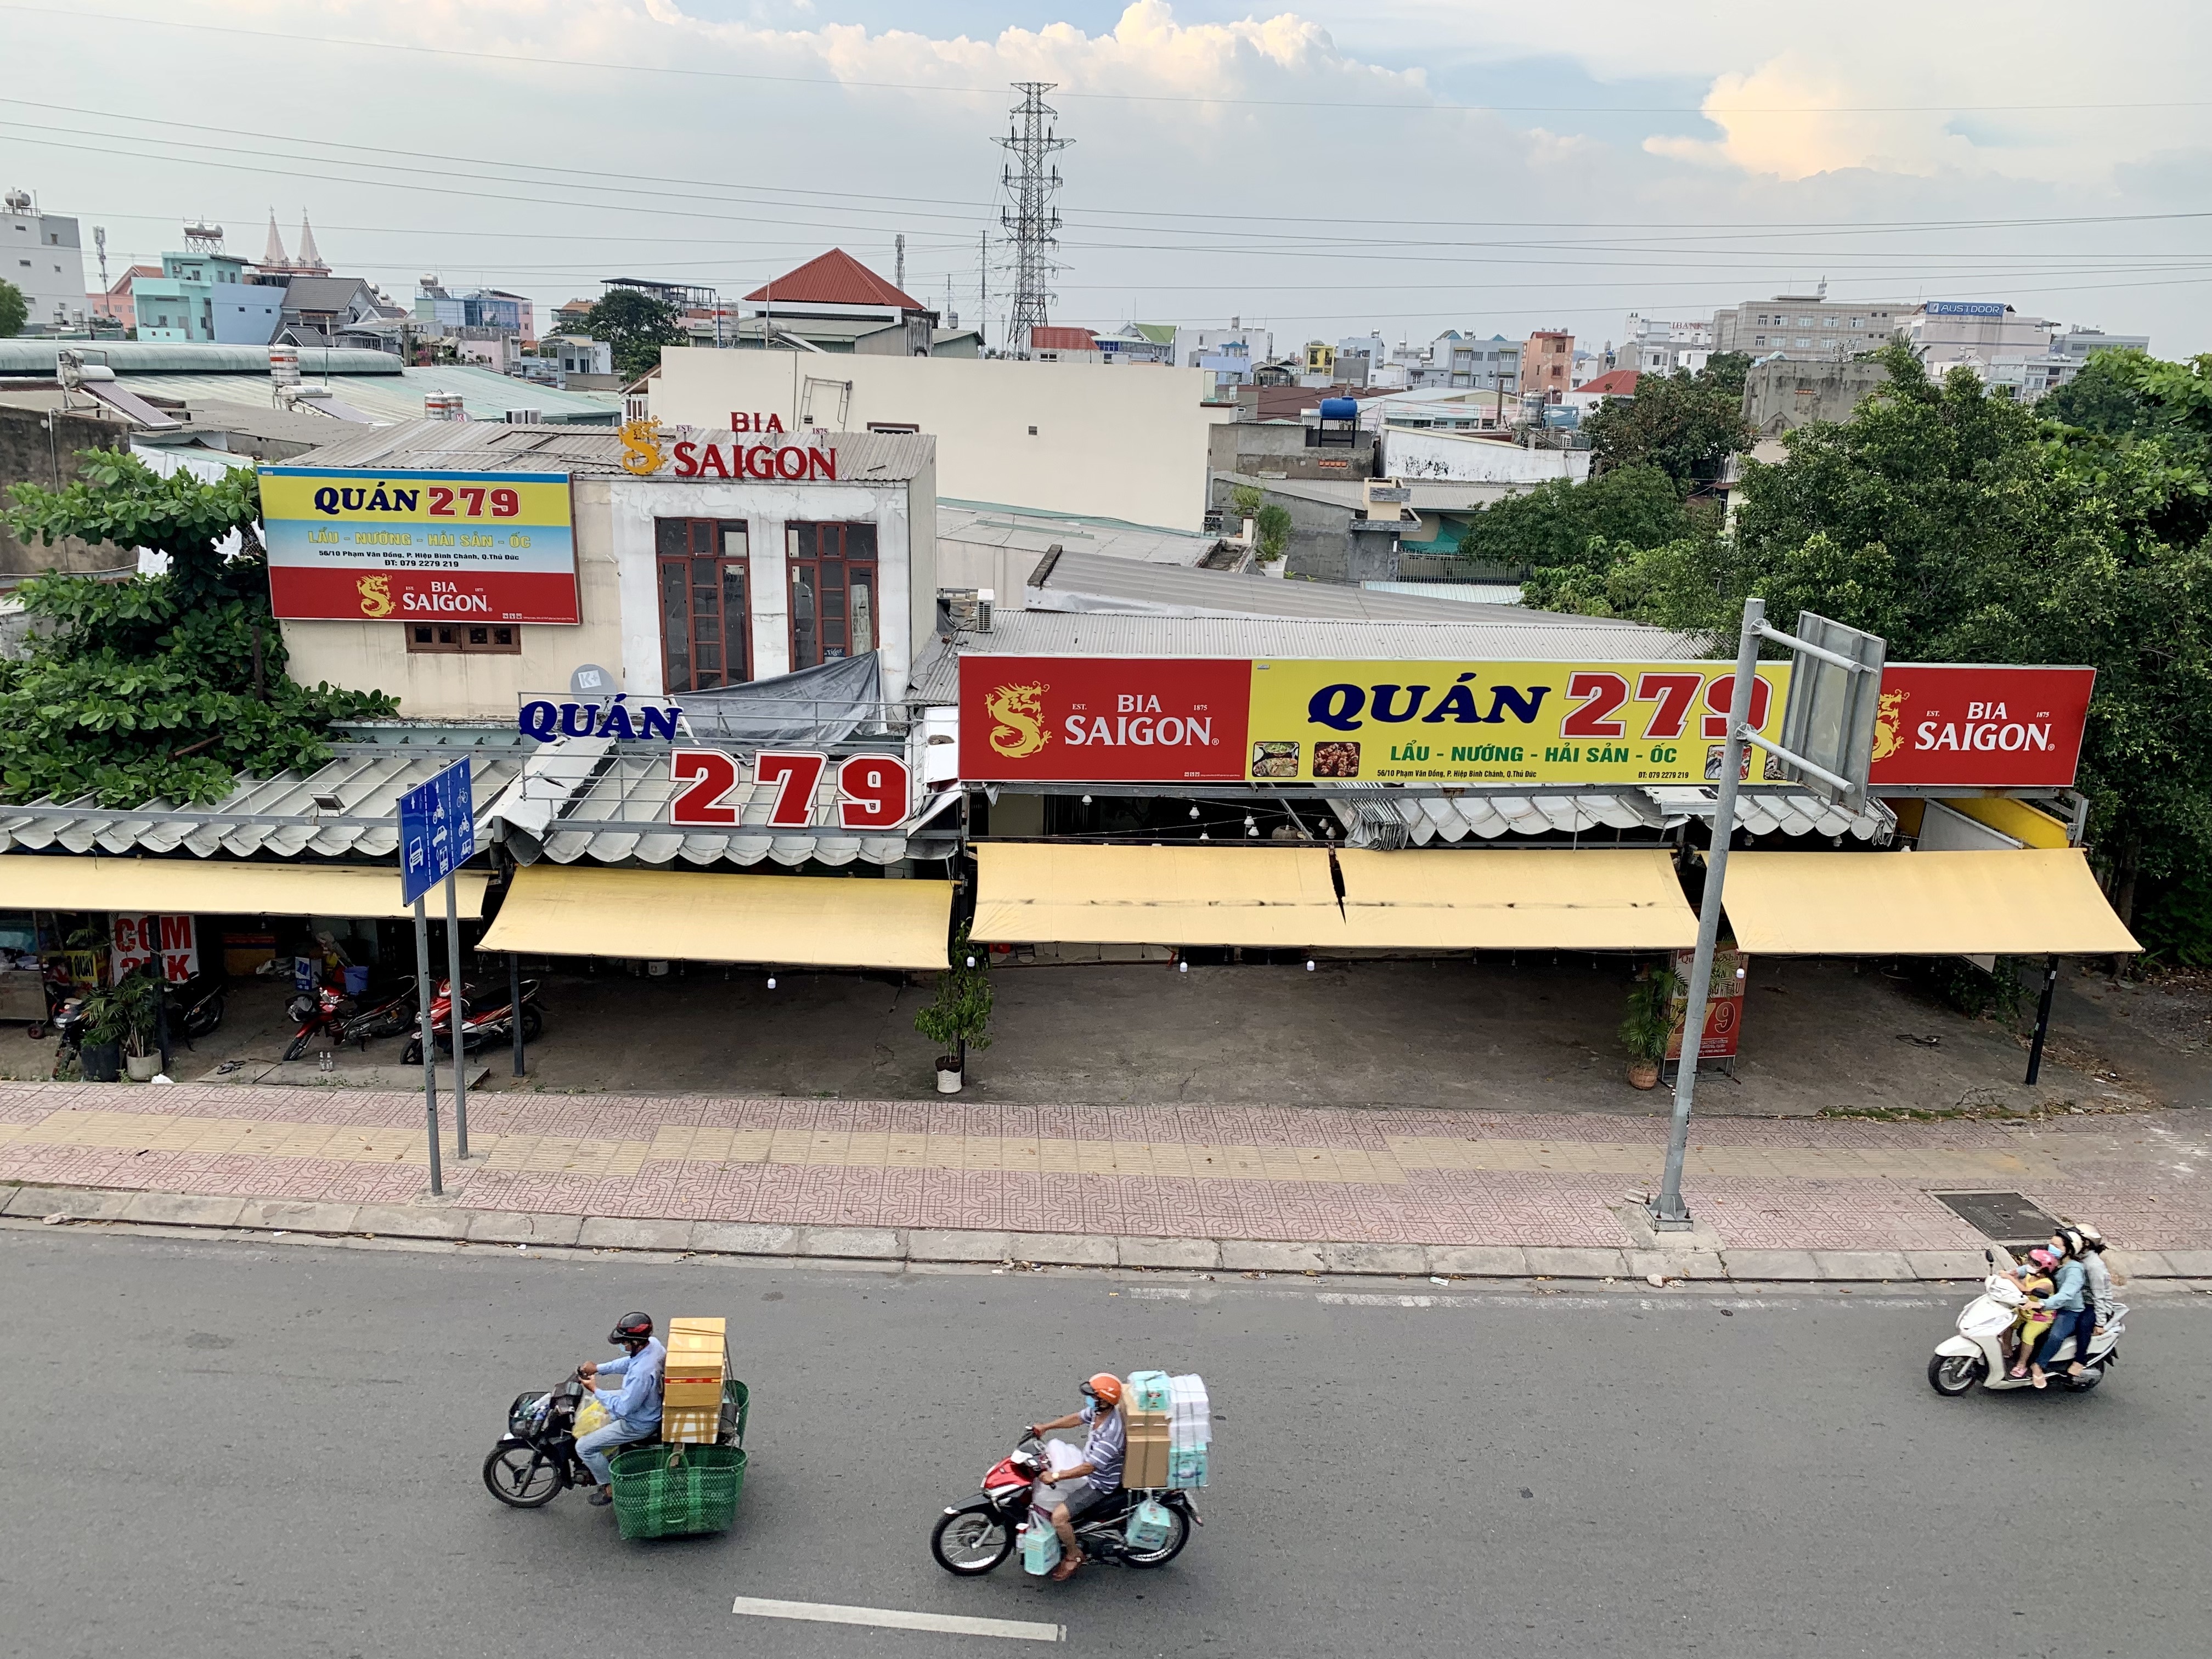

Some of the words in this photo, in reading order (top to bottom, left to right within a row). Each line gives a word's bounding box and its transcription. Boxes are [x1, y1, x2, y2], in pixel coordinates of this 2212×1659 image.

[1940, 304, 2000, 313] AUSTDOOR
[730, 411, 785, 433] BIA
[673, 442, 837, 481] SAIGON
[314, 481, 420, 515] QUÁN
[427, 486, 520, 518] 279
[427, 530, 455, 546] HẢI
[460, 531, 493, 547] SẢN
[431, 581, 458, 592] BIA
[402, 592, 487, 612] SAIGON
[1117, 695, 1163, 713] BIA
[1308, 672, 1551, 731] QUÁN
[1559, 671, 1773, 740] 279
[1967, 702, 2008, 719] BIA
[518, 691, 684, 743] QUÁN
[1065, 715, 1212, 746] SAIGON
[1915, 721, 2052, 751] SAIGON
[1390, 740, 1430, 761] LẨU
[1451, 743, 1523, 761] NƯỚNG
[1544, 742, 1580, 762] HẢI
[1586, 742, 1629, 763] SẢN
[1650, 742, 1677, 763] ỐC
[1396, 770, 1413, 778] Phạm
[1454, 770, 1468, 779] Hiệp
[668, 747, 913, 830] 279
